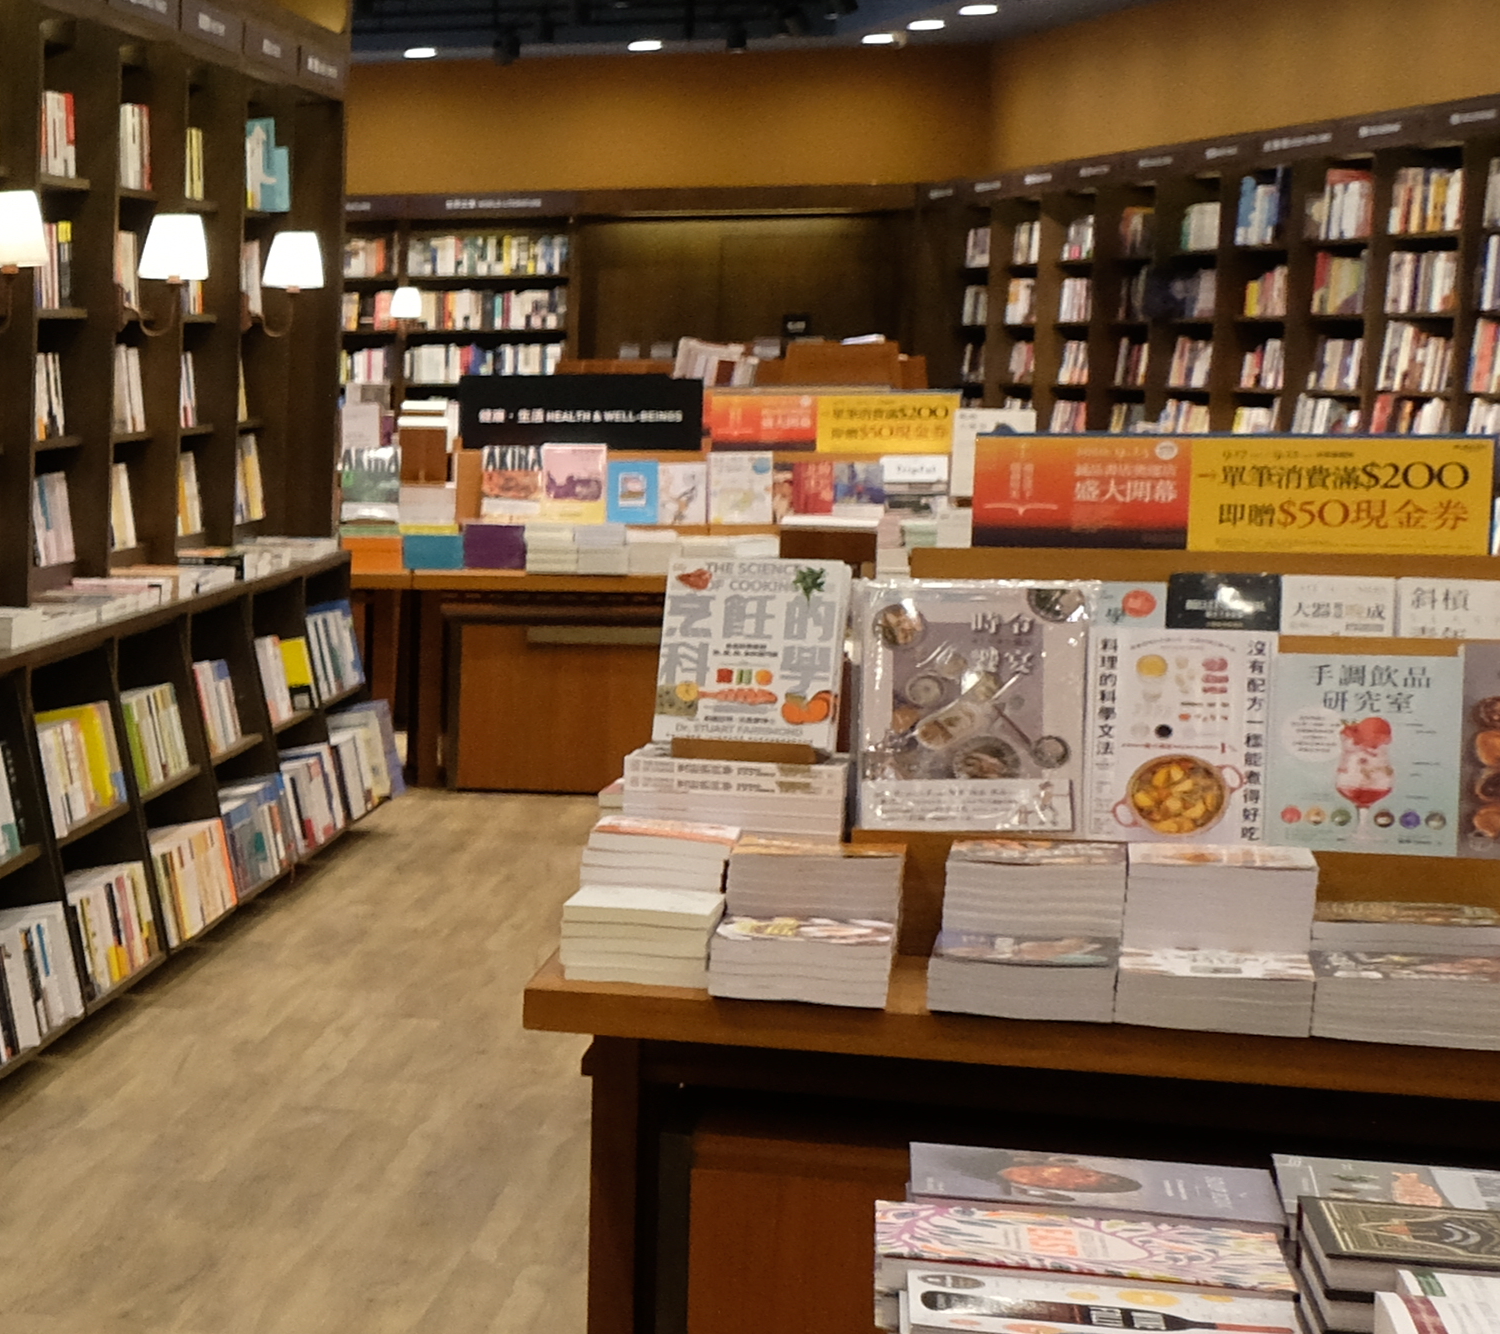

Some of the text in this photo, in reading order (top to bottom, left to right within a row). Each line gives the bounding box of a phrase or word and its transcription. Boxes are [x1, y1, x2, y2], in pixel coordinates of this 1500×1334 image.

[545, 409, 592, 425] HEALTH
[484, 445, 543, 473] AKIRA
[1218, 459, 1471, 492] 單筆消費滿$200
[1073, 477, 1178, 504] 盛大開幕
[1218, 496, 1470, 532] 即贈$50現金券
[665, 593, 838, 642] 烹飪的
[1308, 663, 1433, 689] 手調飲品
[1096, 638, 1119, 756] 料理的科學文法
[1321, 690, 1416, 715] 研究室
